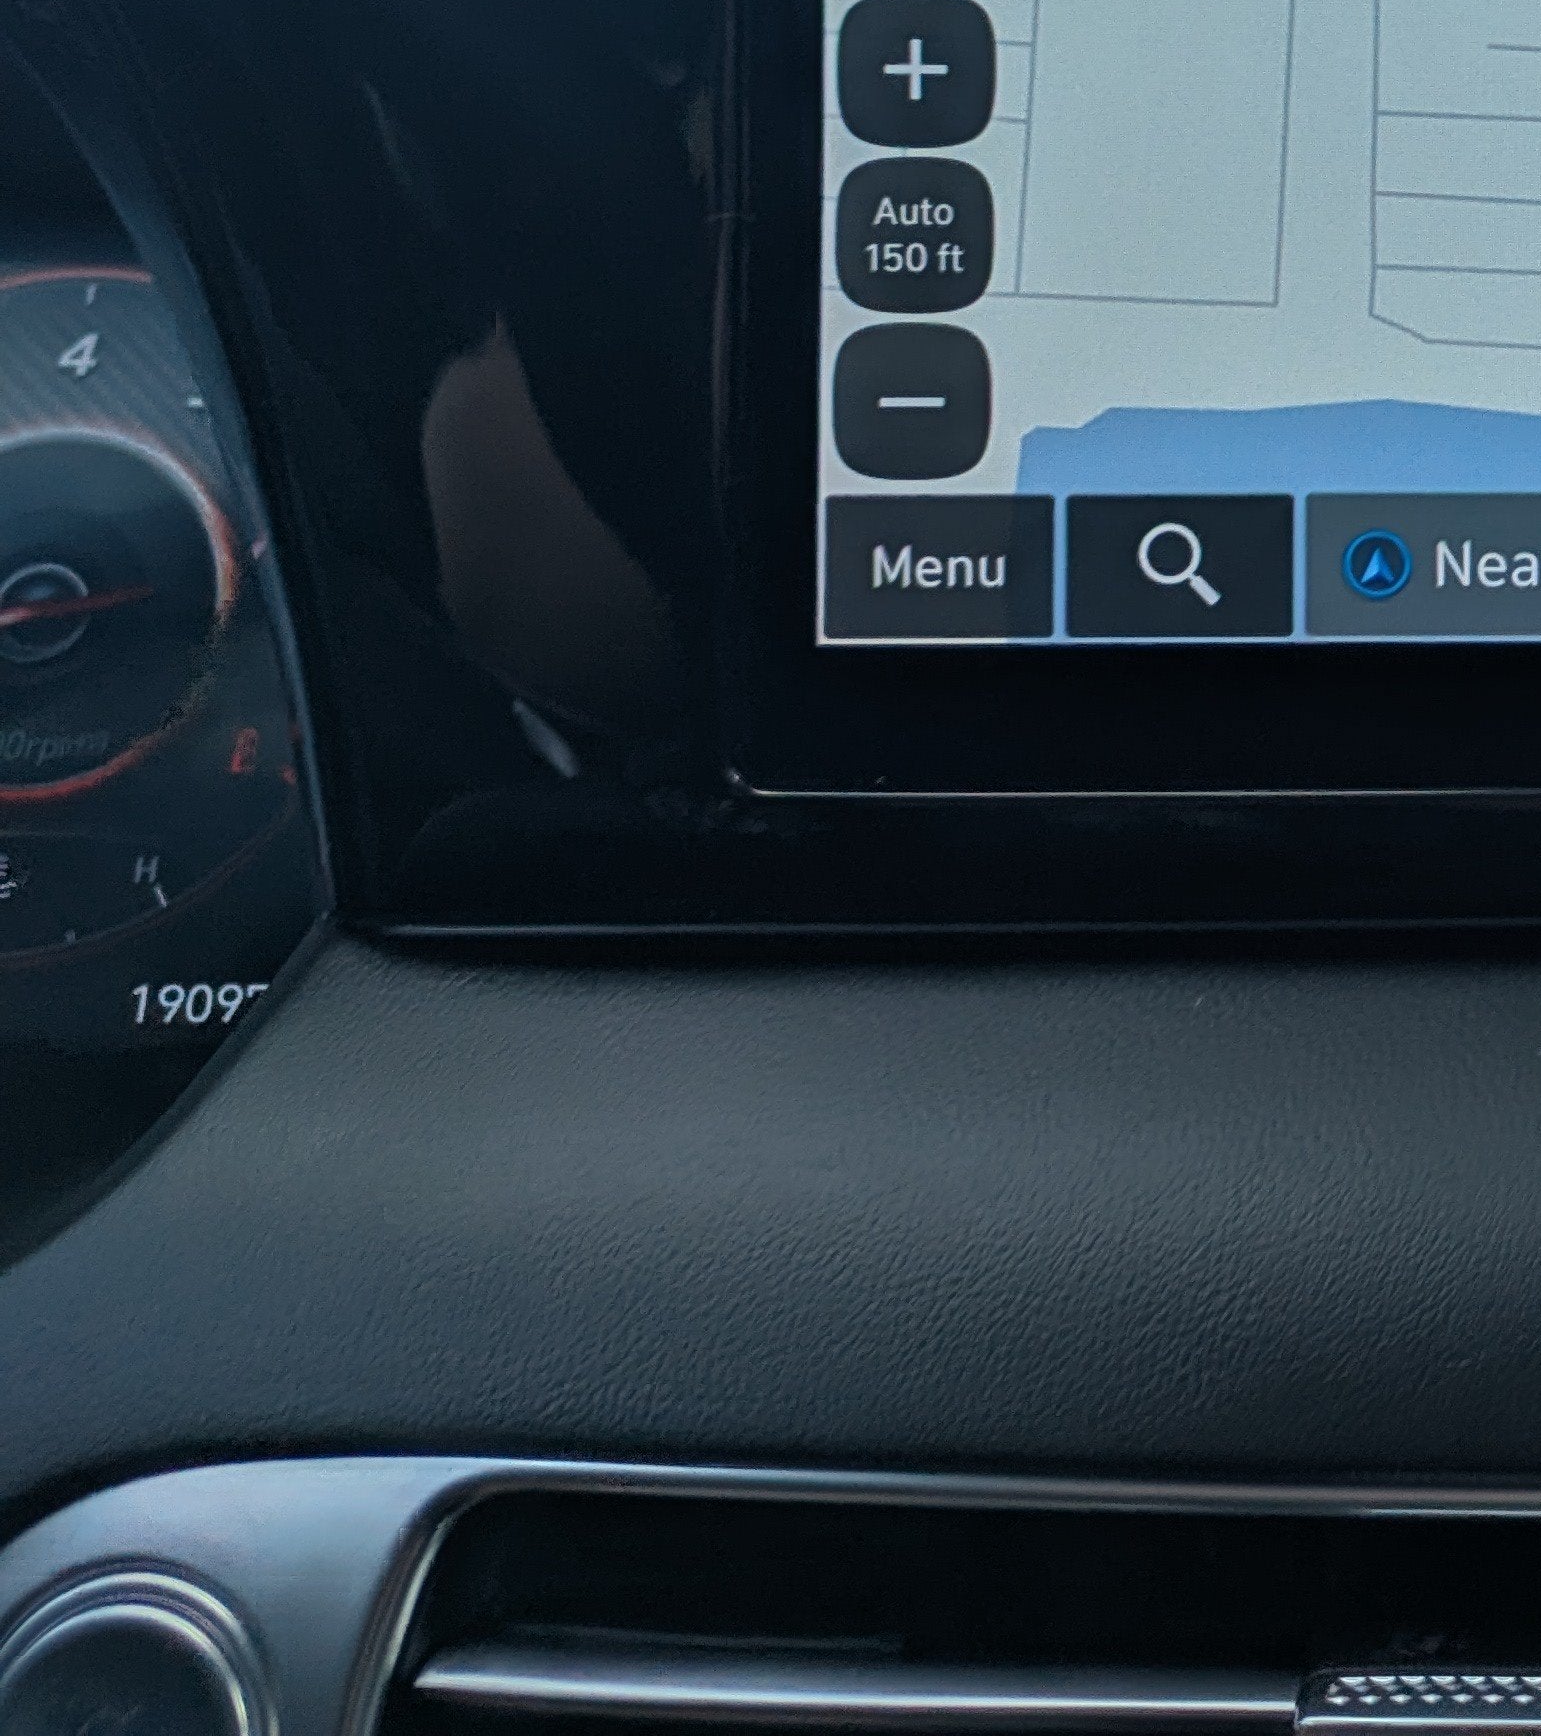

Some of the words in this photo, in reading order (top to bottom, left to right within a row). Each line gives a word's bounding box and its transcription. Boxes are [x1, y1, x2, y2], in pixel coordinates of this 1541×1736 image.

[873, 197, 956, 228] Auto
[864, 242, 928, 274] 150
[935, 242, 965, 274] ft
[57, 332, 100, 378] 4
[870, 543, 1007, 591] Menu
[133, 855, 161, 884] H
